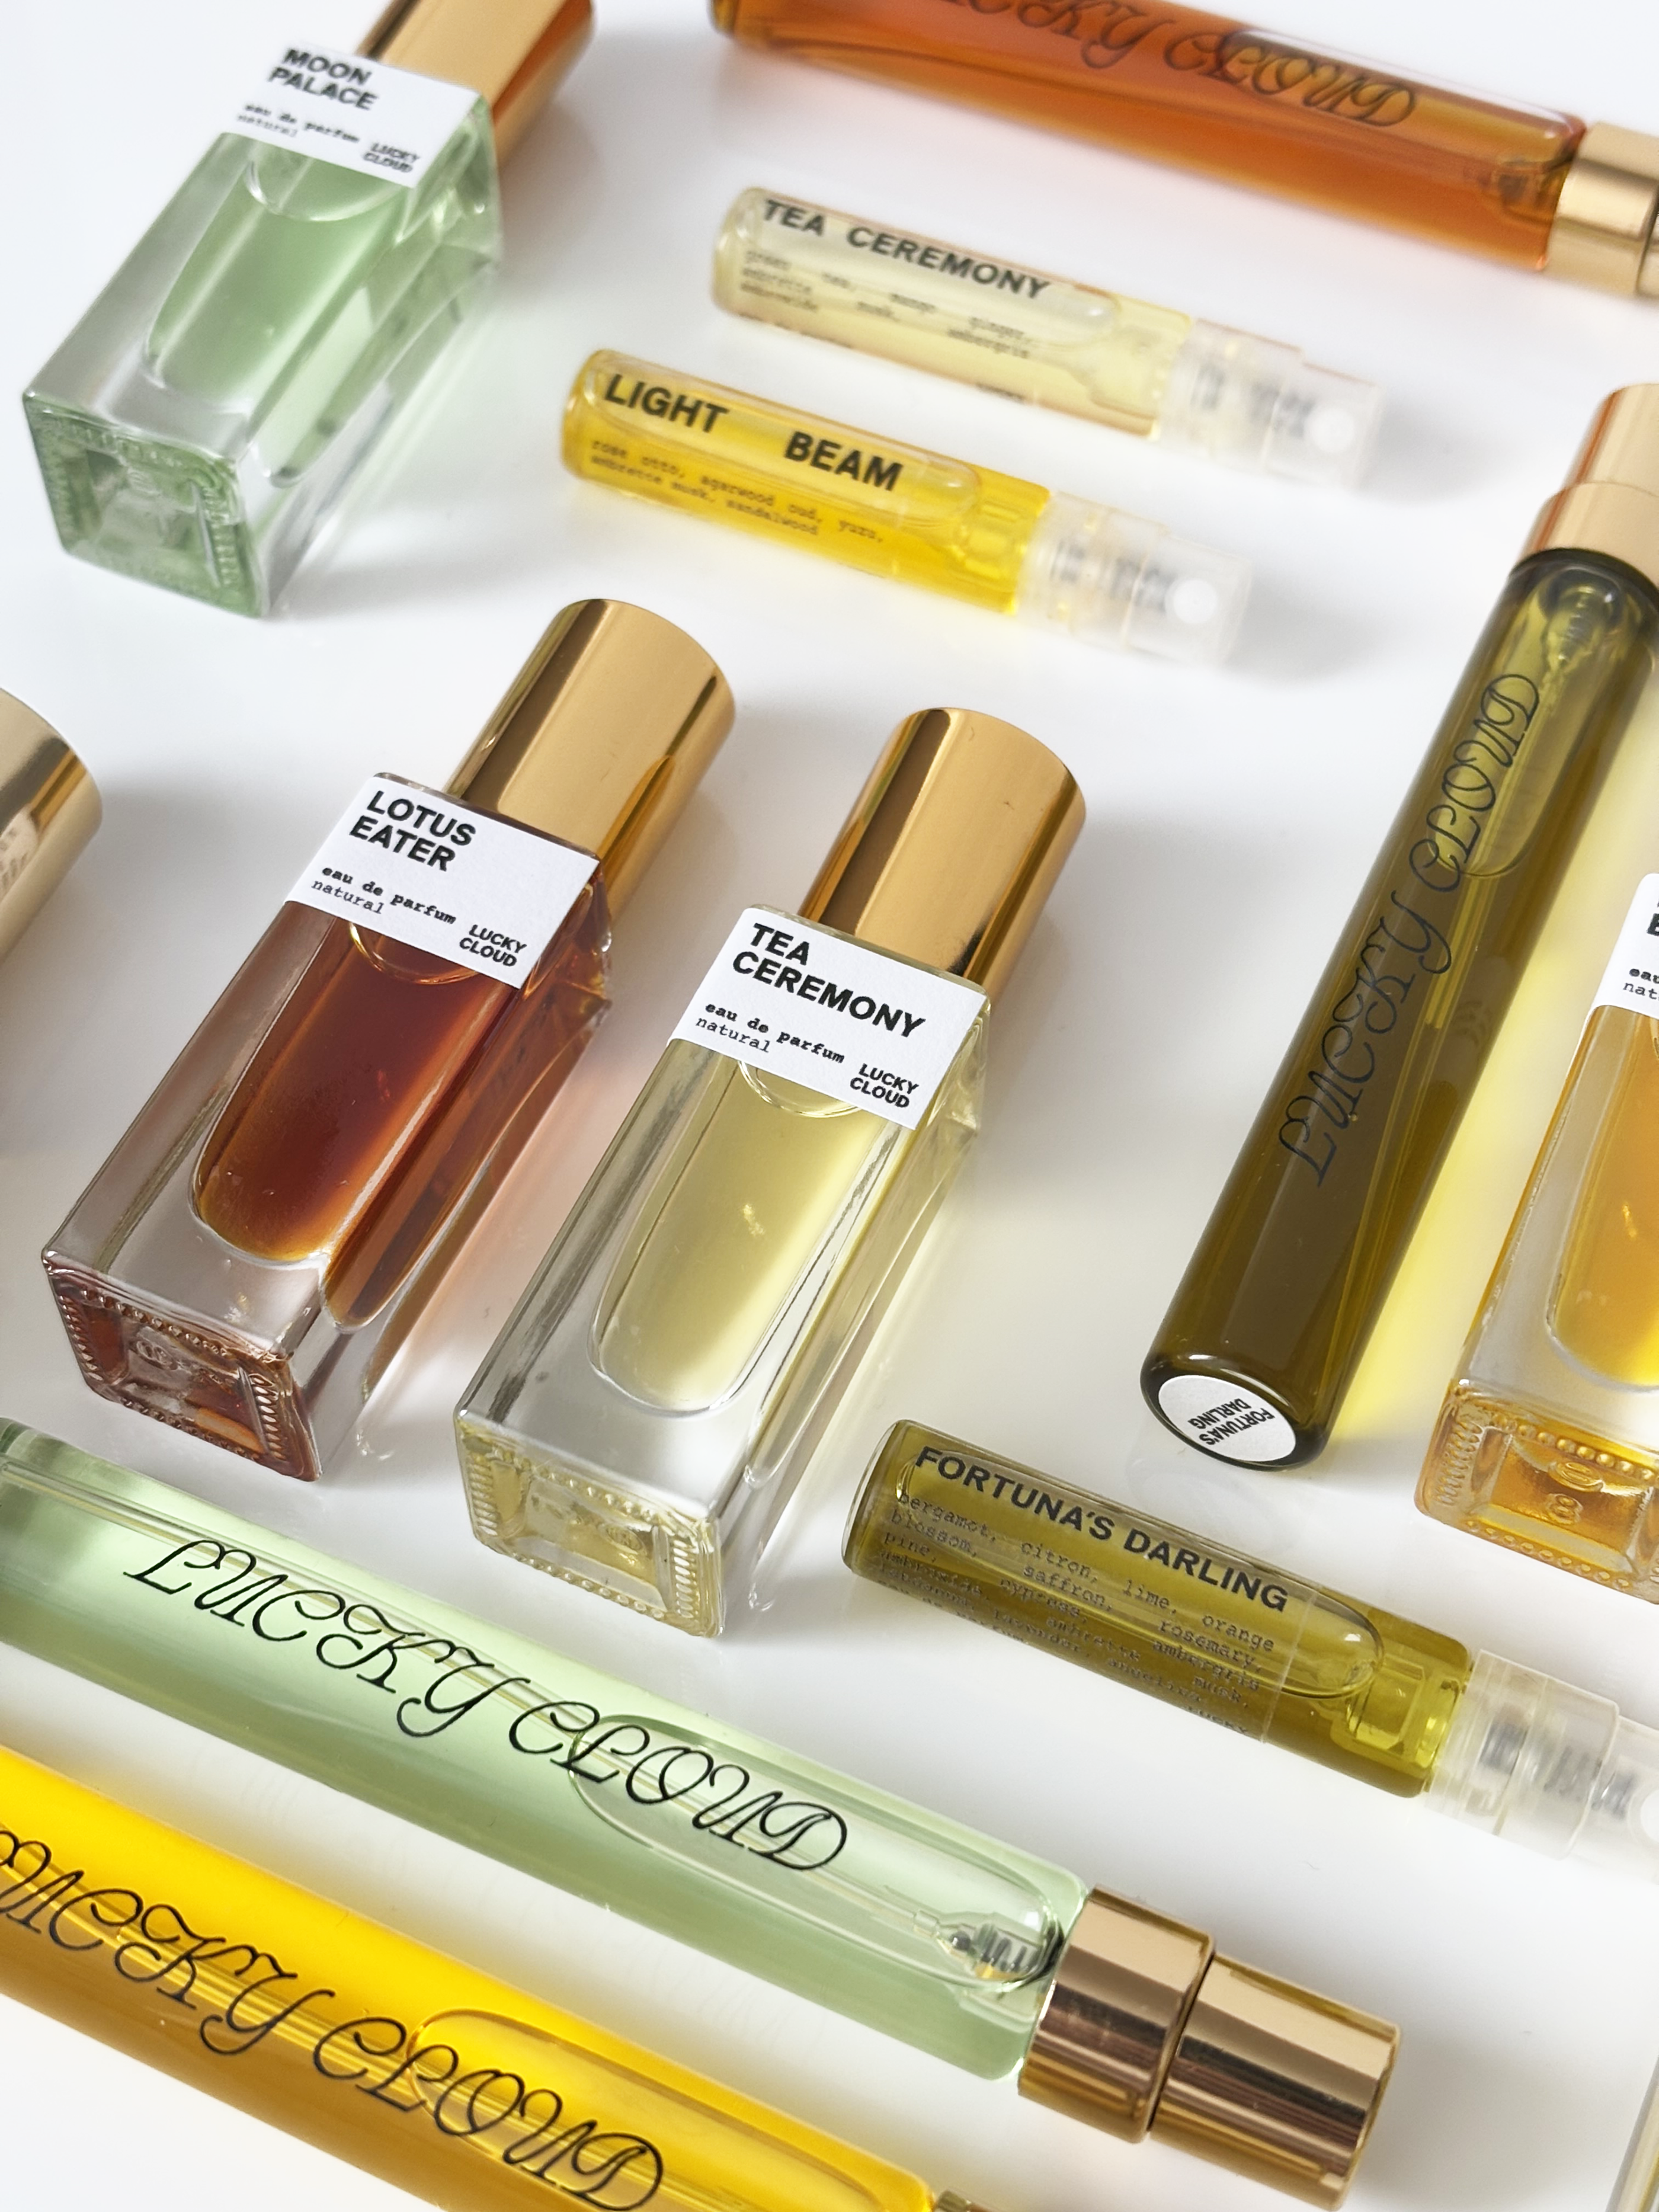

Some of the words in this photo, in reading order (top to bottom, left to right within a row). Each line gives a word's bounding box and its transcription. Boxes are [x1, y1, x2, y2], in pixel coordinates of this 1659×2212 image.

[283, 47, 372, 85] MOON
[267, 66, 377, 110] PALACE
[236, 114, 299, 138] natural
[304, 121, 359, 142] parfum
[363, 152, 413, 174] CLOUD
[371, 143, 420, 164] LUCKY
[763, 199, 828, 237] TEA
[845, 225, 1052, 299] CEREMONY
[604, 373, 729, 434] LIGHT
[784, 430, 904, 491] BEAM
[366, 790, 476, 846] LOTUS
[348, 815, 456, 872] EATER
[311, 879, 384, 914] natural
[322, 866, 353, 885] eau
[362, 881, 384, 897] de
[390, 893, 456, 926] parfum
[468, 924, 527, 954] LUCKY
[750, 923, 810, 966] TEA
[1279, 890, 1452, 1187] LUCKY
[1409, 673, 1539, 892] CLOUD
[459, 937, 517, 967] CLOUD
[732, 950, 925, 1038] CEREMONY
[696, 1016, 770, 1053] natural
[704, 1003, 737, 1022] eau
[747, 1017, 769, 1033] de
[776, 1032, 845, 1064] parfum
[850, 1077, 909, 1109] CLOUD
[859, 1063, 919, 1094] LUCKY
[1187, 1398, 1251, 1429] DARLING
[1199, 1408, 1276, 1445] FORTUNA'S
[883, 1532, 937, 1563] pine,
[915, 1445, 1115, 1542] FORTUNA'S
[1123, 1527, 1289, 1613] DARLING
[891, 1509, 977, 1558] blossom,
[1023, 1566, 1113, 1612] saffron,
[1160, 1619, 1262, 1674] rosemary,
[899, 1492, 995, 1542] bergamot,
[1021, 1541, 1098, 1584] citron,
[1123, 1580, 1177, 1615] lime,
[1202, 1615, 1274, 1653] orange
[123, 1539, 531, 1737] LUCKY
[508, 1701, 847, 1871] CLOUD
[313, 2016, 664, 2211] CLOUD
